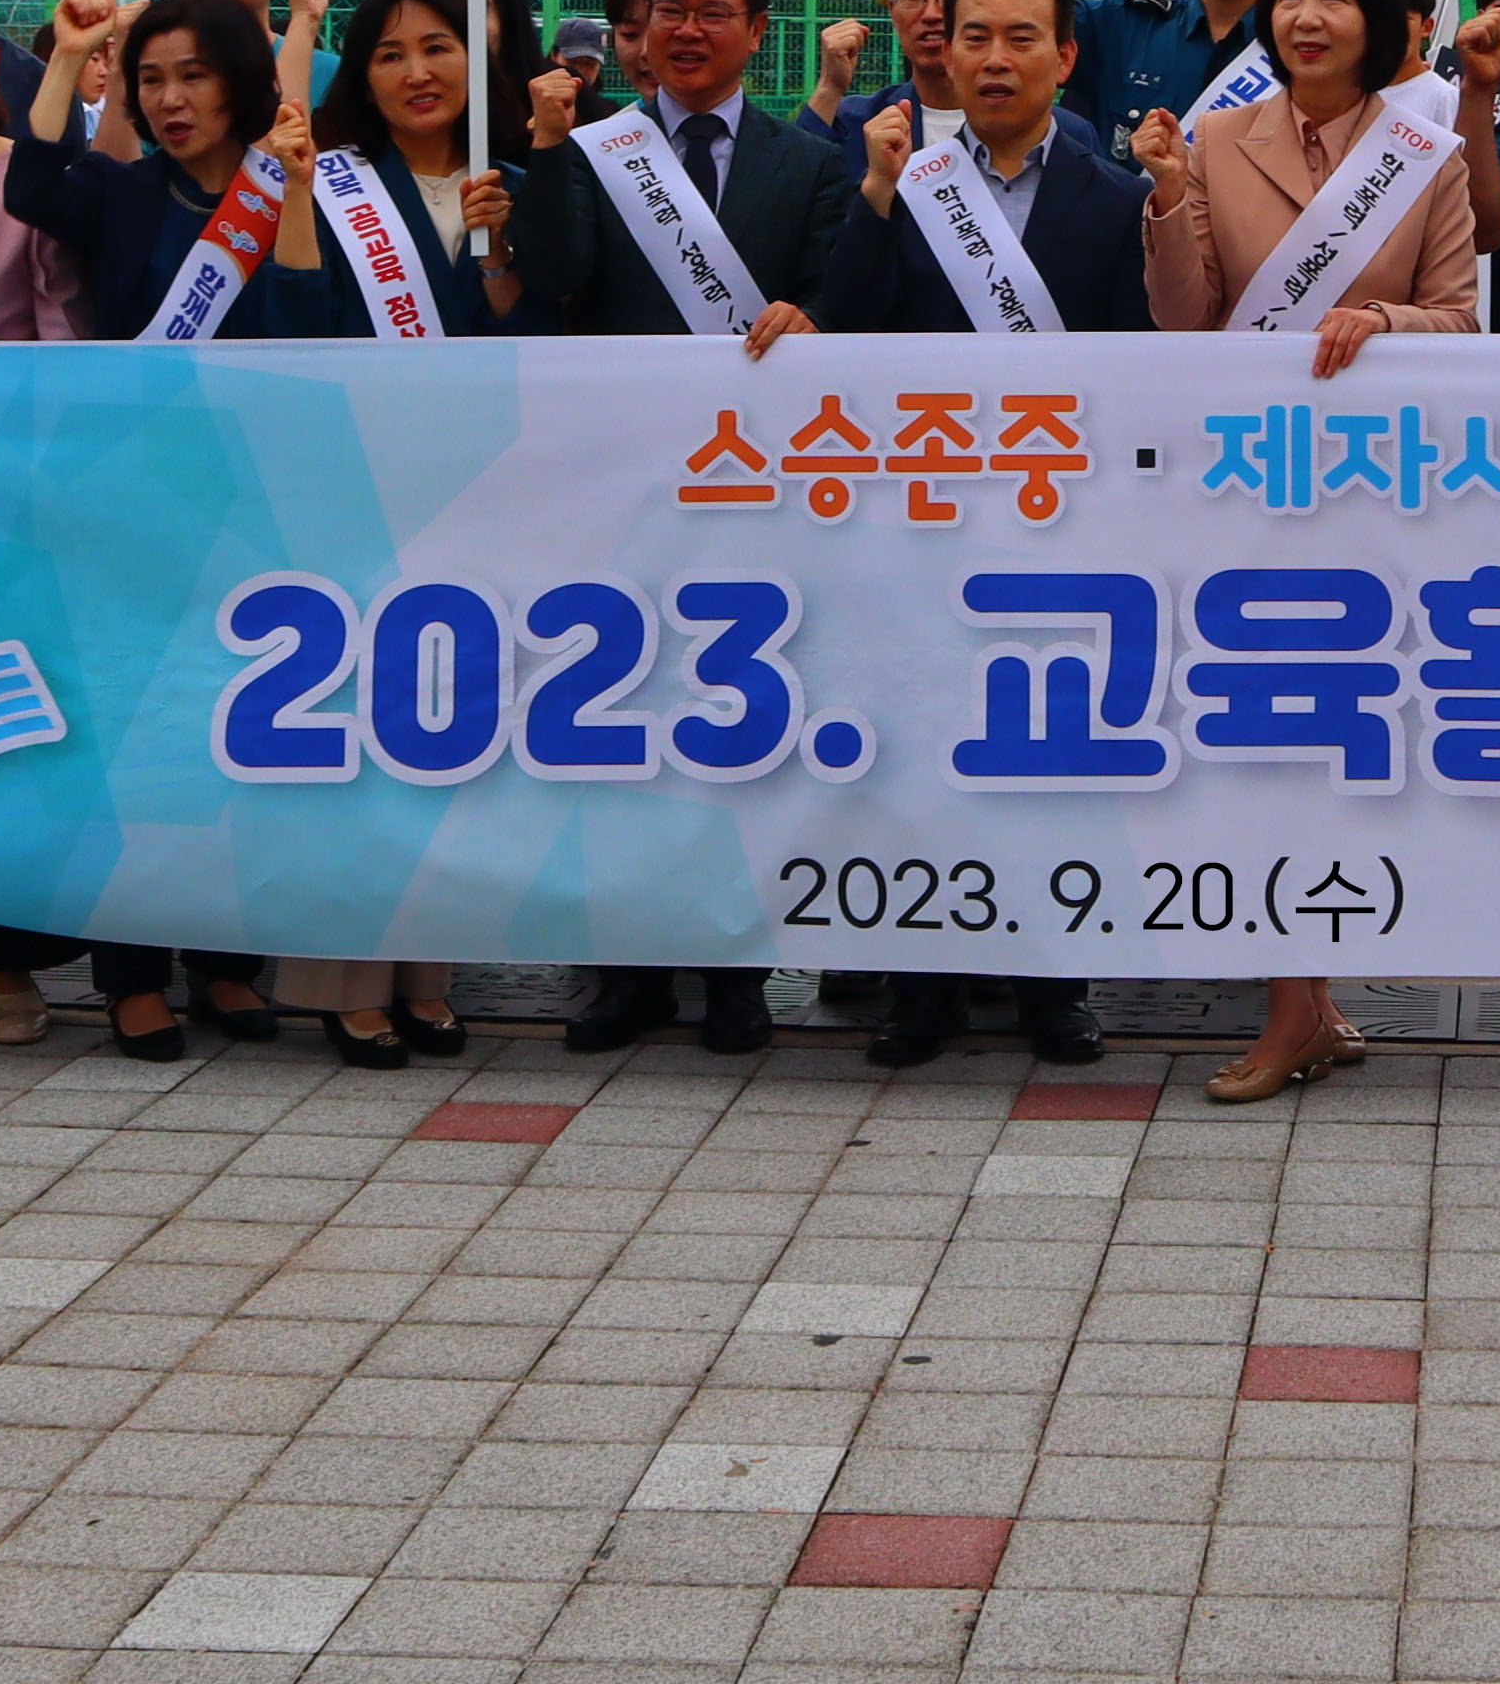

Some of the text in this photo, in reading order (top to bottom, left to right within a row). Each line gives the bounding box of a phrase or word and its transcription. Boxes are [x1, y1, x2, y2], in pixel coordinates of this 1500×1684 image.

[600, 130, 644, 153] STOP
[909, 154, 951, 182] STOP
[1390, 121, 1434, 152] STOP
[315, 153, 365, 198] 회복
[345, 202, 406, 284] 공교육
[623, 156, 683, 226] 학교폭력
[681, 241, 732, 304] 성폭력
[932, 184, 994, 259] 학교폭력
[1343, 152, 1405, 231] 학교폭력
[165, 262, 227, 340] 함께해
[1283, 241, 1339, 306] 성폭력
[678, 392, 1089, 522] 스승존중
[225, 582, 876, 772] 2023.
[780, 857, 1018, 932] 2023.
[1049, 860, 1113, 933] 9.
[1142, 857, 1403, 943] 20.(수)
